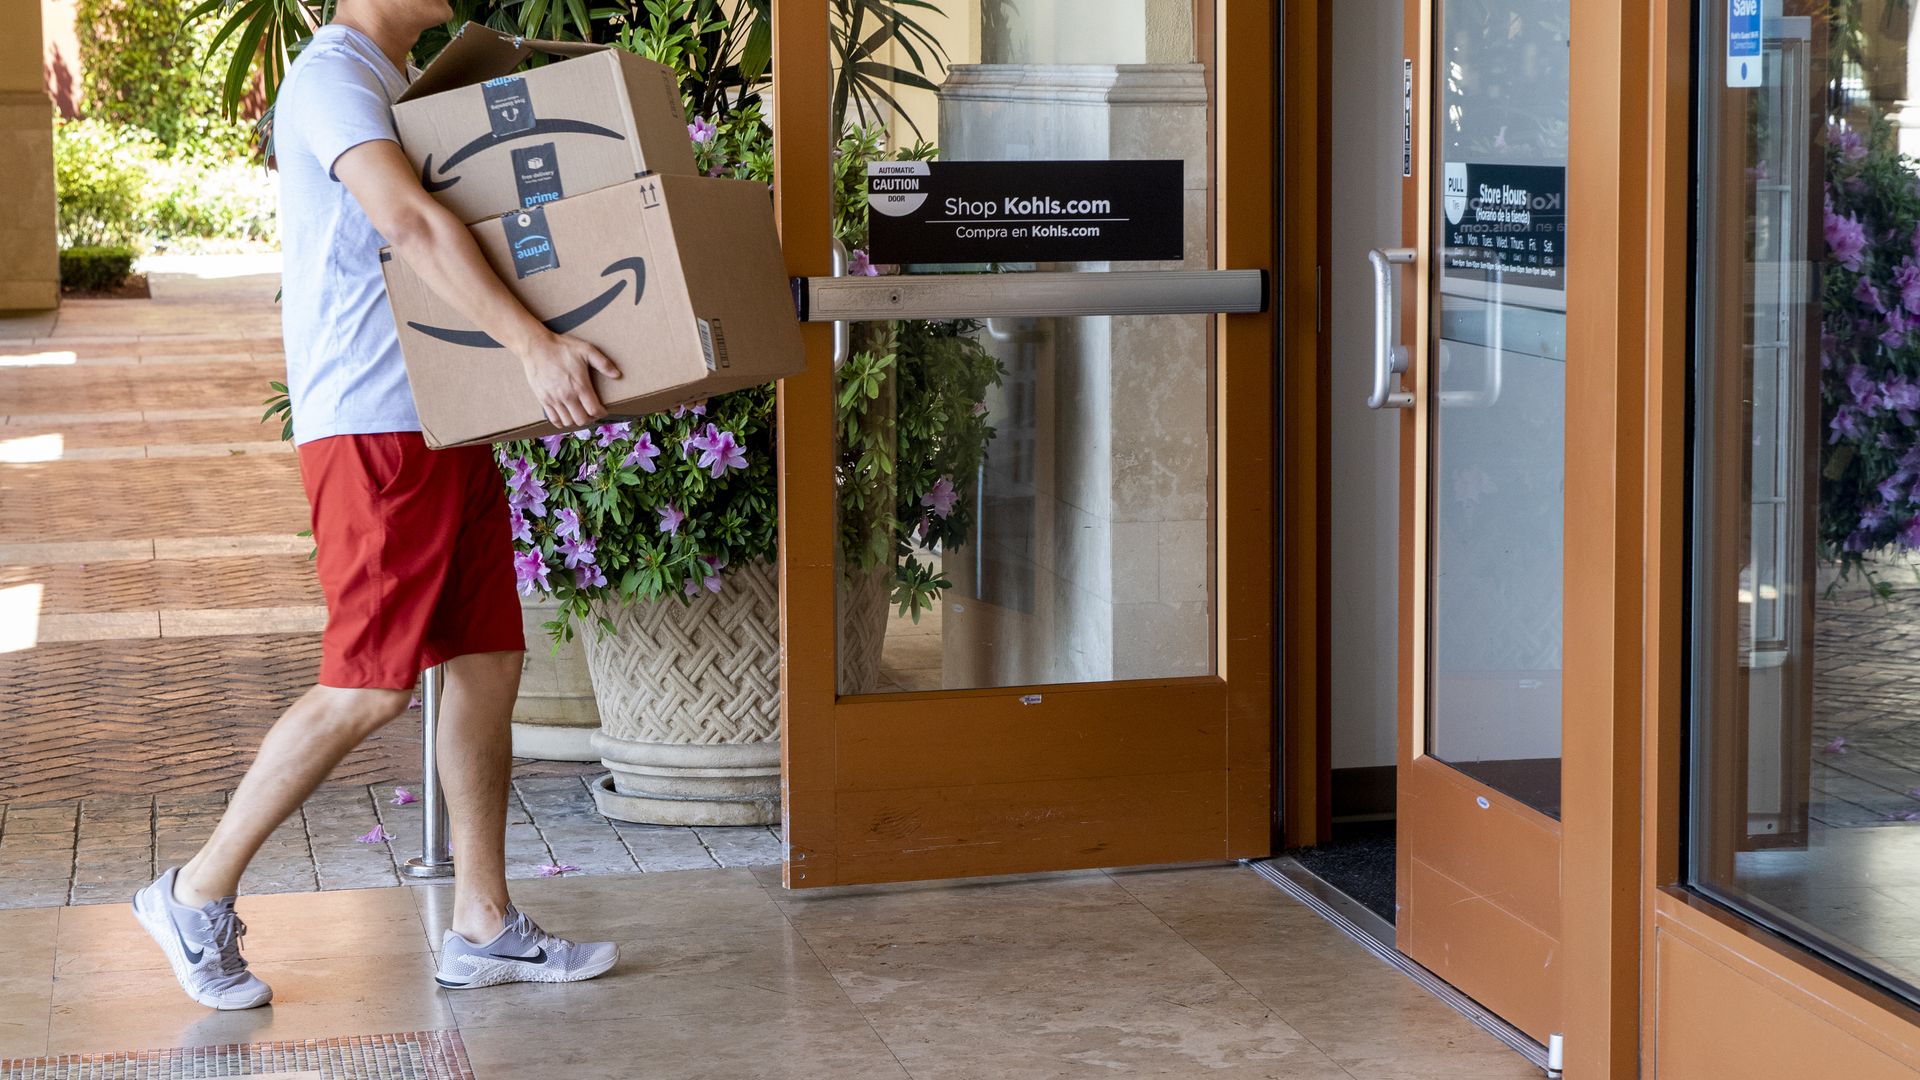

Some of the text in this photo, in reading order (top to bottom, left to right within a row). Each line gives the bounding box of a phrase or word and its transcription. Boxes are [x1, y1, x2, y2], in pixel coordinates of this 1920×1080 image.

[1733, 0, 1757, 16] Save
[485, 77, 519, 88] rime
[872, 178, 920, 191] CAUTION
[1448, 177, 1464, 193] PULL
[524, 192, 560, 208] prime
[888, 195, 906, 203] DOOR
[1480, 183, 1527, 206] Store Hours
[945, 196, 1111, 219] Shop Kohls.com
[1475, 207, 1497, 222] (Horario
[1497, 208, 1505, 222] de
[1511, 210, 1530, 225] tienda)
[956, 225, 1100, 240] Compra en Kohls.com
[516, 240, 550, 259] prime
